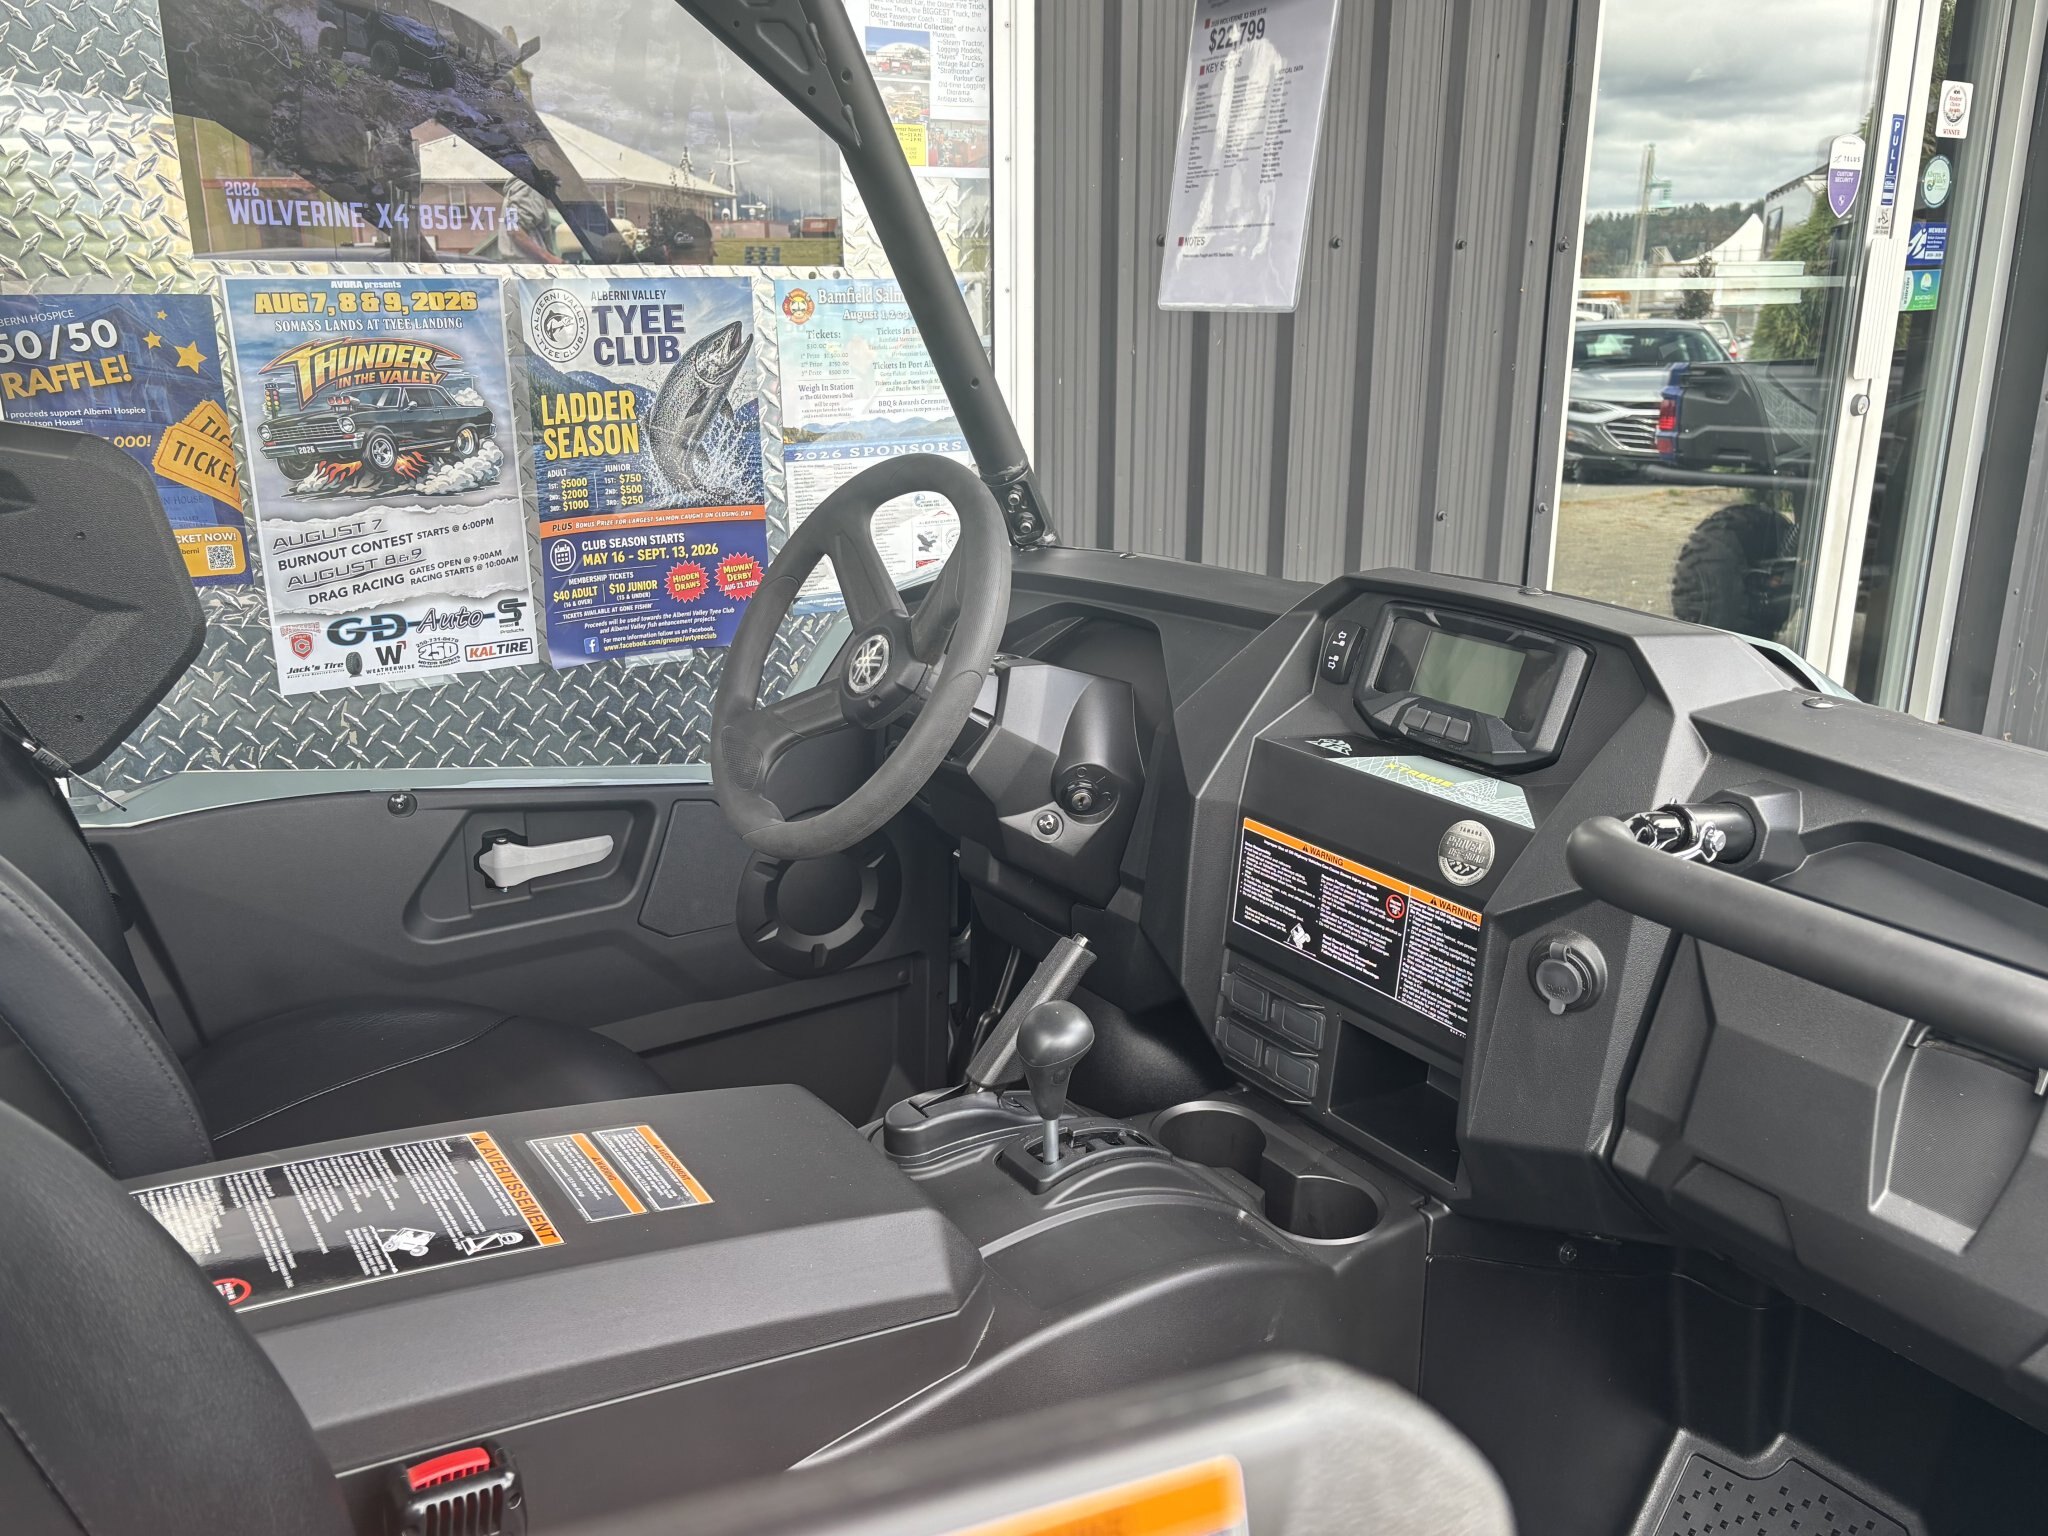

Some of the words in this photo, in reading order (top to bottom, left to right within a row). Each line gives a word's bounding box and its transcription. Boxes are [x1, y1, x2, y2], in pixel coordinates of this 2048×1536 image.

[922, 7, 950, 16] BIGGEST
[1206, 61, 1219, 74] KEY
[1943, 128, 1960, 136] WINNER
[1888, 121, 1900, 174] PULL
[1844, 155, 1861, 163] TELUS
[225, 181, 259, 197] 2026
[419, 204, 461, 231] 850
[469, 206, 519, 232] XT-R
[1184, 236, 1206, 246] NOTES
[364, 281, 402, 290] presents
[254, 292, 310, 314] AUG
[338, 291, 358, 314] 8
[360, 291, 381, 313] &
[411, 290, 478, 312] 2026
[591, 290, 630, 301] ALBERNI
[632, 289, 667, 300] VALLEY
[818, 287, 874, 304] Bamfield
[31, 310, 75, 324] HOSPICE
[591, 304, 686, 336] TYEE
[842, 309, 879, 323] August
[275, 320, 322, 332] SOMASS
[325, 319, 364, 331] LANDS
[366, 318, 381, 331] AT
[382, 318, 412, 330] TYEE
[413, 317, 464, 329] LANDING
[876, 327, 902, 336] Tickets
[806, 329, 841, 340] Tickets:
[593, 335, 681, 367] CLUB
[872, 361, 898, 370] Tickets
[899, 361, 907, 369] In
[908, 360, 923, 369] Port
[0, 354, 133, 400] RAFFLE!
[338, 376, 352, 389] IN
[354, 373, 376, 386] THE
[379, 371, 443, 384] VALLEY
[798, 383, 820, 394] Weigh
[821, 383, 829, 391] In
[829, 382, 854, 391] Station
[541, 390, 637, 426] LADDER
[878, 400, 892, 408] BBQ
[11, 410, 48, 420] proceeds
[50, 409, 82, 419] support
[83, 407, 112, 416] Alberni
[114, 406, 146, 417] Hospice
[54, 418, 84, 427] House!
[543, 422, 640, 461] SEASON
[297, 445, 316, 455] 2026
[793, 450, 842, 461] 2026
[849, 441, 962, 458] SPONSORS
[547, 468, 567, 478] ADULT
[603, 464, 631, 473] JUNIOR
[561, 477, 588, 489] $5000
[619, 473, 642, 484] $750
[562, 488, 589, 500] $2000
[620, 484, 643, 495] $500
[563, 500, 590, 512] $1000
[621, 495, 644, 506] $250
[273, 522, 366, 550] AUGUST
[371, 518, 383, 531] 7
[552, 522, 573, 532] PLUS
[176, 535, 202, 544] CKET
[204, 532, 237, 542] NOW!
[278, 547, 348, 571] BURNOUT
[351, 533, 414, 555] CONTEST
[417, 526, 450, 540] STARTS
[462, 517, 494, 531] 6:00PM
[581, 539, 607, 551] CLUB
[609, 536, 648, 549] SEASON
[649, 532, 685, 545] STARTS
[582, 552, 609, 567] MAY
[611, 551, 625, 563] 16
[637, 547, 670, 561] SEPT.
[671, 545, 689, 560] 13,
[691, 543, 719, 557] 2026
[409, 563, 436, 576] GATES
[437, 558, 462, 570] OPEN
[472, 550, 502, 562] 9:00AM
[410, 573, 443, 586] RACING
[444, 565, 475, 578] STARTS
[485, 555, 519, 569] 10:00AM
[723, 562, 754, 573] MIDWAY
[288, 558, 379, 588] AUGUST
[568, 575, 608, 586] MEMBERSHIP
[608, 571, 634, 582] TICKETS
[672, 572, 700, 583] HIDDEN
[726, 572, 752, 583] DERBY
[308, 587, 349, 605] DRAG
[352, 573, 405, 595] RACING
[608, 582, 626, 595] $10
[627, 579, 658, 592] JUNIOR
[675, 581, 701, 592] DRAWS
[553, 590, 570, 604] $40
[571, 586, 598, 599] ADULT
[415, 606, 484, 634] Auto
[563, 612, 583, 620] TICKETS
[583, 609, 611, 617] AVAILABLE
[584, 620, 608, 629] Proceeds
[641, 614, 662, 622] towards
[630, 623, 646, 632] Valley
[658, 619, 693, 627] enhancement
[693, 616, 717, 625] projects.
[626, 632, 657, 640] information
[689, 625, 715, 633] Facebook.
[286, 664, 321, 675] Jack's
[323, 661, 344, 671] Tire
[366, 663, 416, 675] WEATHERWISE
[1446, 835, 1485, 854] PROVEN
[1310, 846, 1344, 867] WARNING
[1448, 847, 1486, 864] OFF-ROAD
[1440, 900, 1478, 922] WARNING
[594, 1160, 618, 1181] WARNING
[657, 1149, 691, 1181] AVERTISSEMENT
[478, 1147, 557, 1240] AVERTISSEMENT
